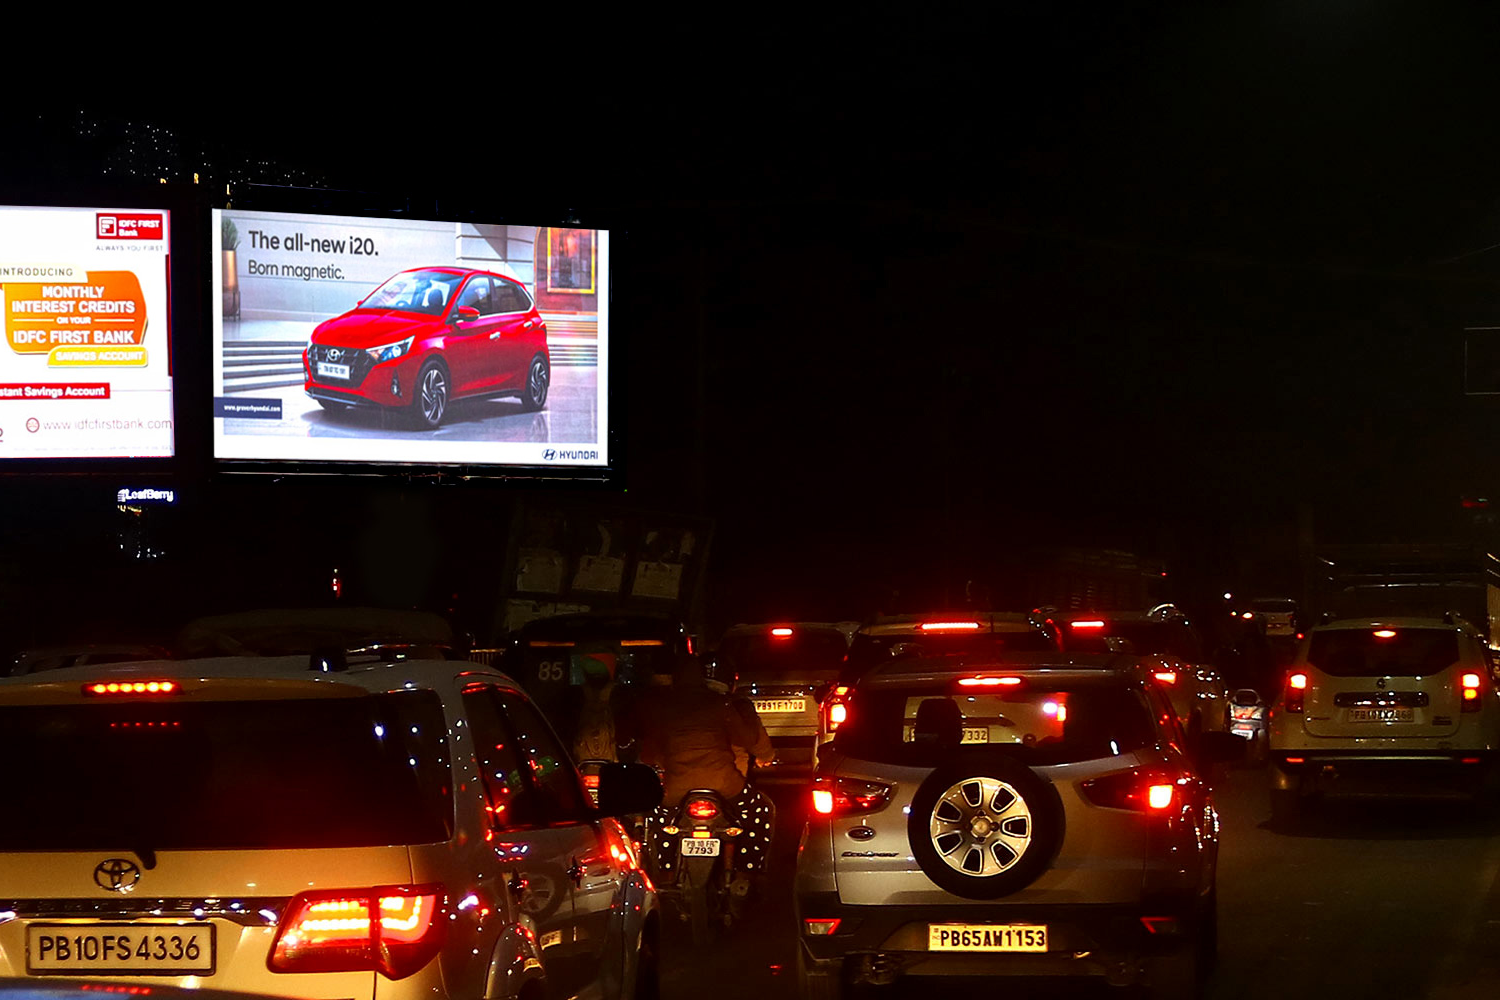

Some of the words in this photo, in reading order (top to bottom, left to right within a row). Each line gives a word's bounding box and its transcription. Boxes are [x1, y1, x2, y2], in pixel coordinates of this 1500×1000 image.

[137, 219, 160, 228] FIRST
[248, 230, 280, 250] The
[284, 232, 346, 254] all-new
[349, 236, 379, 256] i20.
[0, 267, 74, 276] INTRODUCING
[248, 259, 278, 276] Born
[282, 263, 345, 281] magnetic.
[42, 285, 104, 298] MONTHLY
[12, 300, 76, 313] INTEREST
[78, 300, 135, 313] CREDITS
[13, 330, 46, 344] IDFC
[50, 330, 90, 344] FIRST
[93, 330, 134, 343] BANK
[55, 351, 96, 361] SAVINGS
[98, 351, 144, 361] ACCOUNT
[24, 386, 62, 398] Savings
[65, 386, 105, 396] Account
[559, 450, 599, 460] HYUNDAI
[537, 660, 565, 681] 85
[688, 847, 714, 855] 7793
